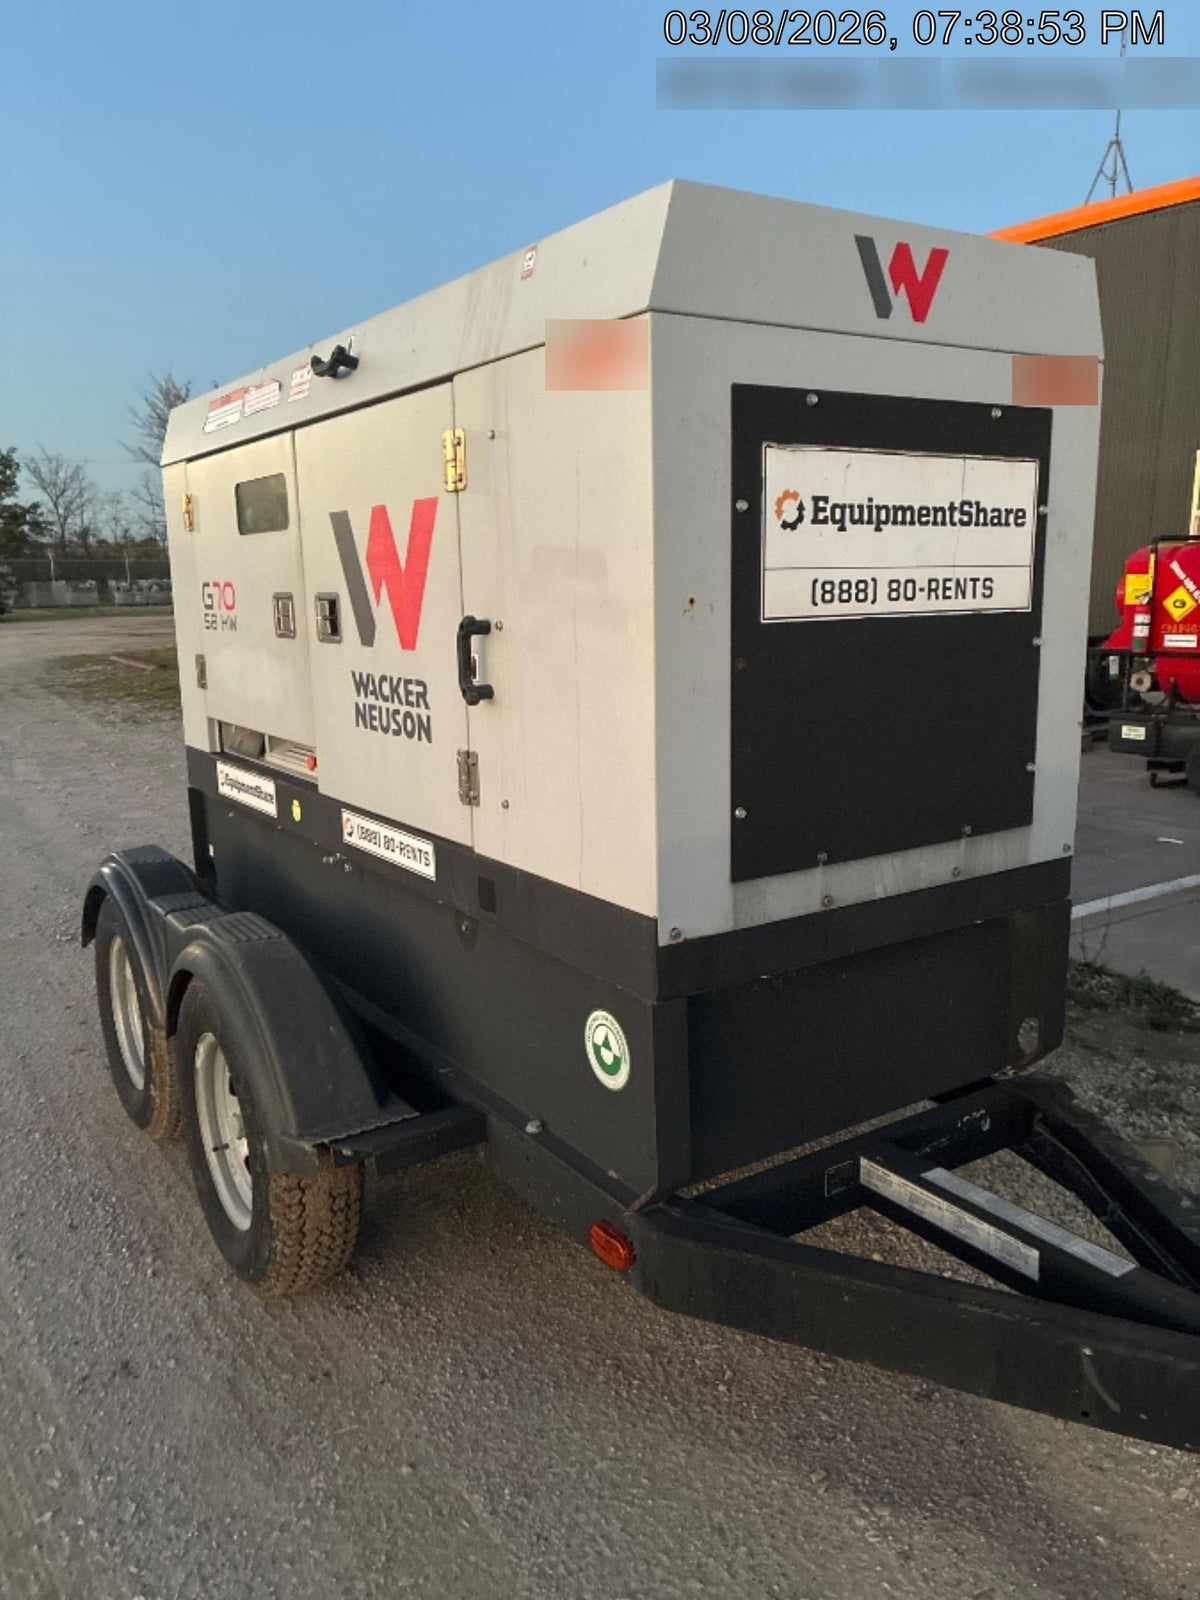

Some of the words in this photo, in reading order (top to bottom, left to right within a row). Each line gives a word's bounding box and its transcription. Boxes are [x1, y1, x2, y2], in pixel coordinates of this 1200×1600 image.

[810, 495, 1027, 532] EquipmentShare
[201, 581, 236, 611] G70
[811, 577, 878, 606] (888)
[886, 577, 994, 602] 80-RENTS
[351, 669, 431, 711] WACKER
[354, 701, 433, 744] NEUSON
